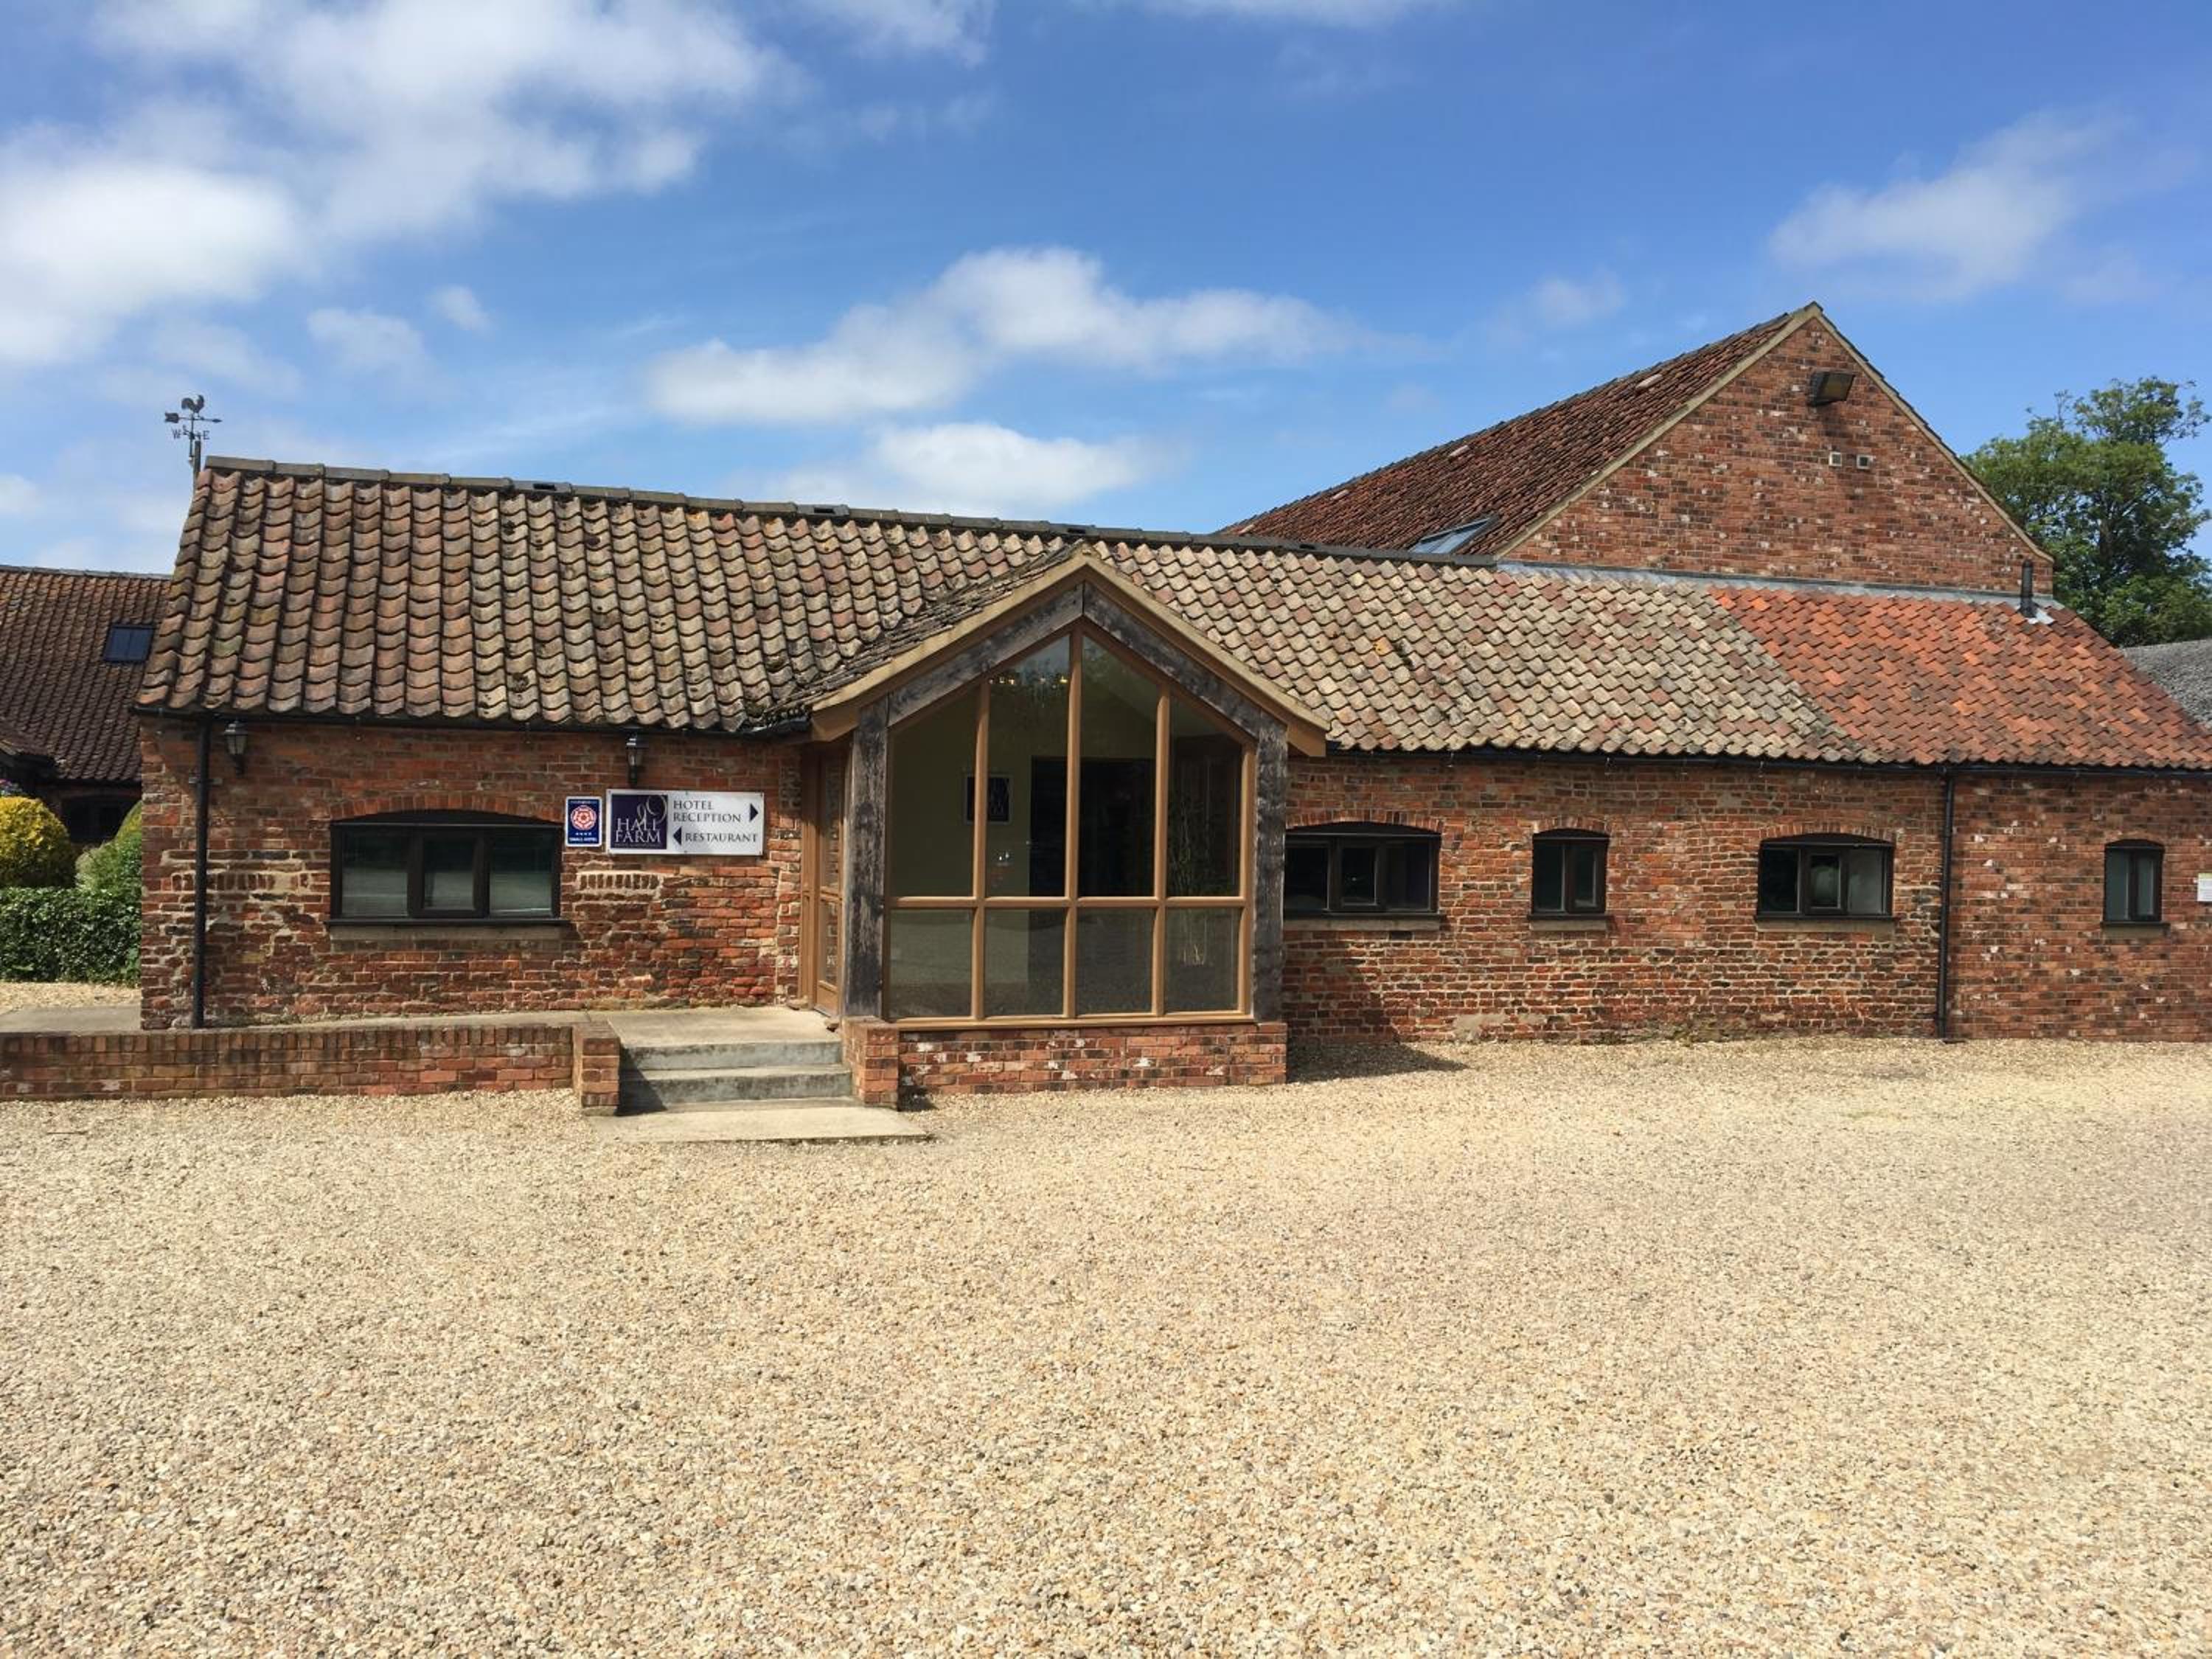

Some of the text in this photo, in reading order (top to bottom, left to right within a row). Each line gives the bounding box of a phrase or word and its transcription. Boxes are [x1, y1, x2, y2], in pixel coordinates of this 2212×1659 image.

[673, 800, 714, 810] HOTEL
[673, 812, 742, 823] RECEPTION
[617, 818, 661, 831] HALL
[615, 830, 661, 843] FARM
[685, 832, 758, 843] RESTAURANT
